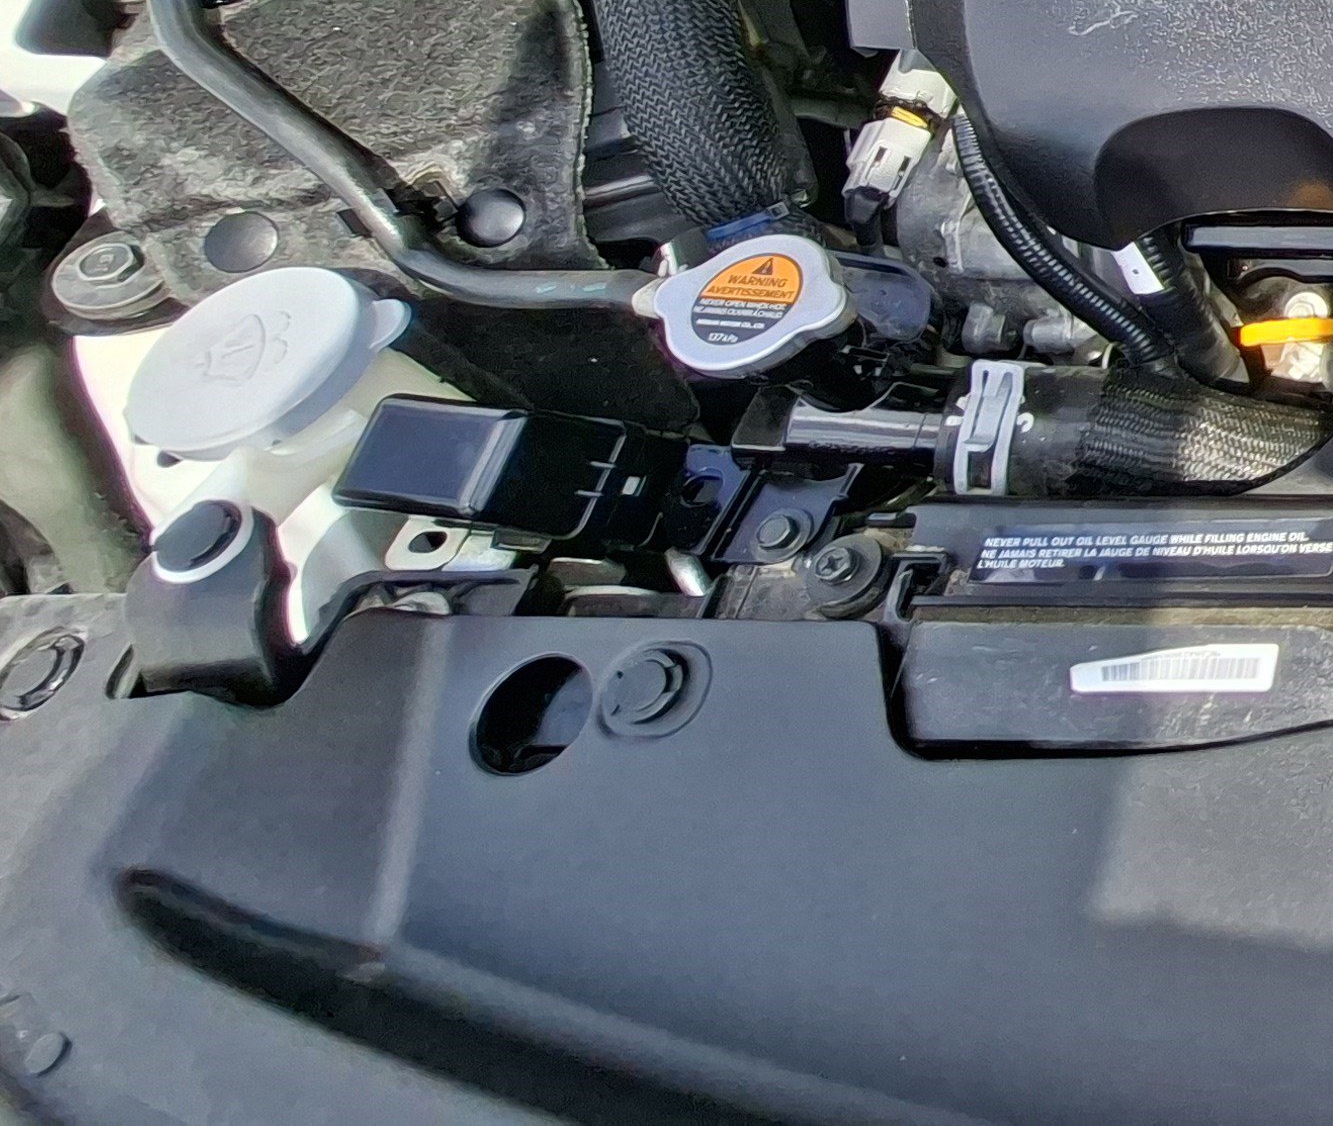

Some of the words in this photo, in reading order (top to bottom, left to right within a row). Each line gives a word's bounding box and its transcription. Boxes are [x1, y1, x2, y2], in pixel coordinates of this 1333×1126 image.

[728, 275, 788, 287] WARNING
[707, 286, 795, 299] AVERTISSEMENT
[984, 537, 1020, 547] NEVER
[1022, 537, 1049, 547] PULL
[1051, 536, 1075, 546] OUT
[1076, 536, 1093, 546] OIL
[1095, 535, 1127, 546] LEVEL
[1130, 534, 1168, 545] GAUGE
[1170, 534, 1203, 544] WHILE
[1204, 533, 1245, 543] FILLING
[1246, 532, 1286, 543] ENGINE
[1288, 532, 1310, 542] OIL.
[981, 549, 996, 559] NE
[998, 549, 1036, 559] JAMAIS
[1038, 548, 1083, 558] RETIRER
[1083, 548, 1097, 558] LA
[1098, 547, 1133, 558] JAUGE
[1135, 547, 1151, 557] DE
[1152, 545, 1192, 556] NIVEAU
[1193, 544, 1235, 556] D'HUILE
[1235, 543, 1298, 555] LORSQU'ON
[977, 559, 1016, 569] L'HUILE
[1018, 558, 1065, 569] MOTEUR.
